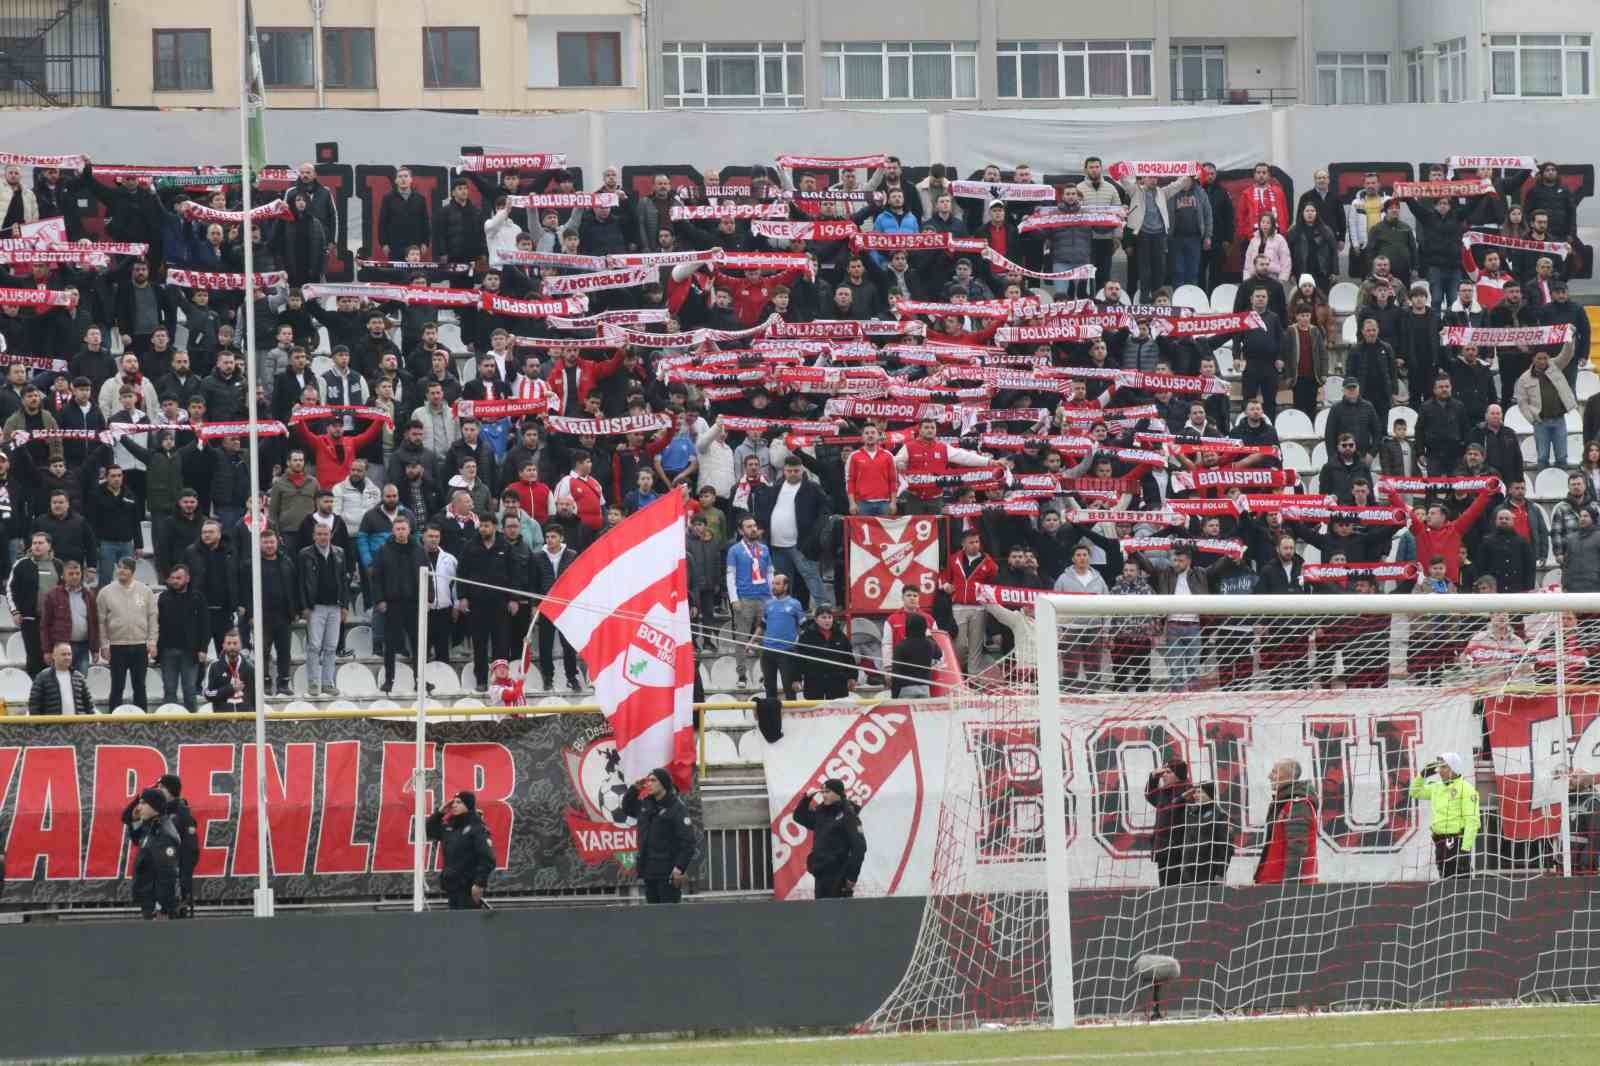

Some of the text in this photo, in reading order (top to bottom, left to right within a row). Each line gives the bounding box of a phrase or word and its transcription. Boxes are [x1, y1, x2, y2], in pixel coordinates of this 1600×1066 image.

[486, 156, 541, 168] BOLUSPOR
[1487, 157, 1521, 167] TAYFA
[706, 185, 751, 197] BOLUSPOR
[1402, 183, 1480, 197] BOLUSPOR
[532, 194, 593, 206] BOLUSPOR
[697, 205, 763, 218] BOLUSPOR
[820, 224, 854, 237] 1965
[868, 234, 945, 247] BOLUSPOR
[1483, 235, 1545, 251] BOLUSPOR
[492, 297, 562, 313] BOLUSPOR
[1107, 305, 1172, 317] BOLUSPOR
[1061, 315, 1117, 328] BOLUSPOR
[1177, 317, 1240, 332] BOLUSPOR
[778, 323, 854, 336] BOLUSPOR
[1021, 326, 1077, 340] BOLUSPOR
[629, 335, 693, 347] BOLUSPOR
[1471, 330, 1543, 343] BOLUSPOR
[985, 354, 1047, 365] BOLUSPOR
[1145, 377, 1202, 390] BOLUSPOR
[855, 402, 914, 417] BOLUSPOR
[568, 414, 656, 433] BOLUSPOR
[1198, 470, 1272, 484] BOLUSPOR
[1088, 511, 1163, 521] BOLUSPOR
[861, 520, 931, 545] 1 9
[864, 572, 936, 599] 6 5
[963, 711, 1423, 864] BOLU
[576, 830, 638, 851] YAREN
